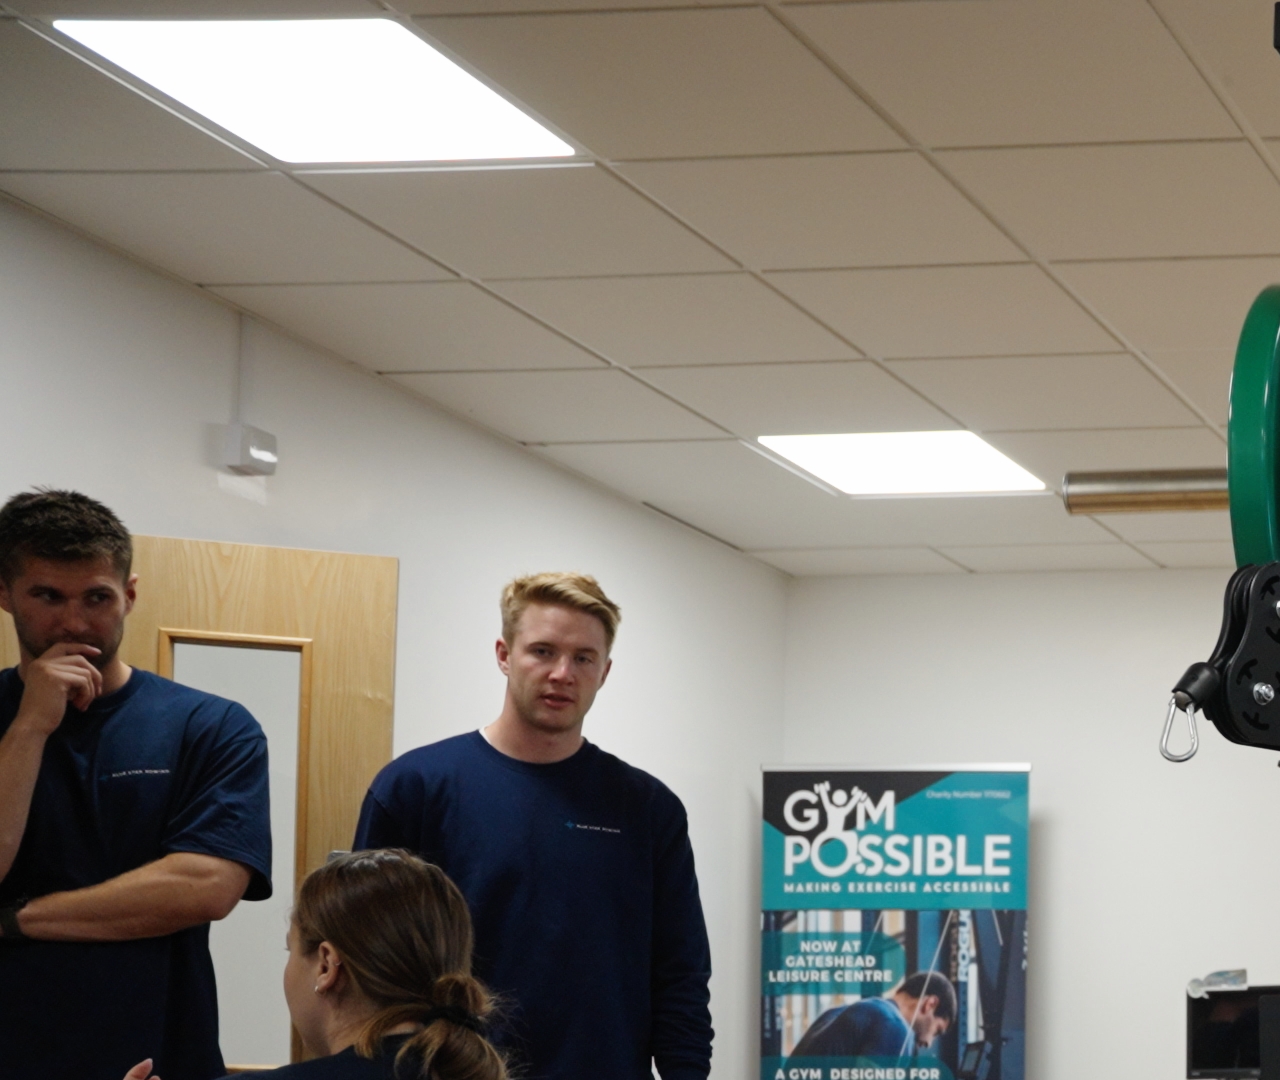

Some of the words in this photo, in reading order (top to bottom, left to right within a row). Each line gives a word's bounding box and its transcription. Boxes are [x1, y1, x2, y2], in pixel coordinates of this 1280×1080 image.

[783, 781, 895, 831] GYM
[783, 834, 1011, 877] POSSIBLE
[784, 882, 841, 893] MAKING
[848, 882, 916, 893] EXERCISE
[923, 882, 1011, 893] ACCESSIBLE
[800, 941, 837, 953] NOW
[841, 941, 861, 953] AT
[785, 956, 876, 968] GATESHEAD
[769, 970, 830, 982] LEISURE
[834, 970, 893, 982] CENTRE
[775, 1068, 785, 1080] A
[789, 1068, 822, 1080] GYM
[830, 1068, 905, 1080] DESIGNED
[910, 1068, 940, 1080] FOR
